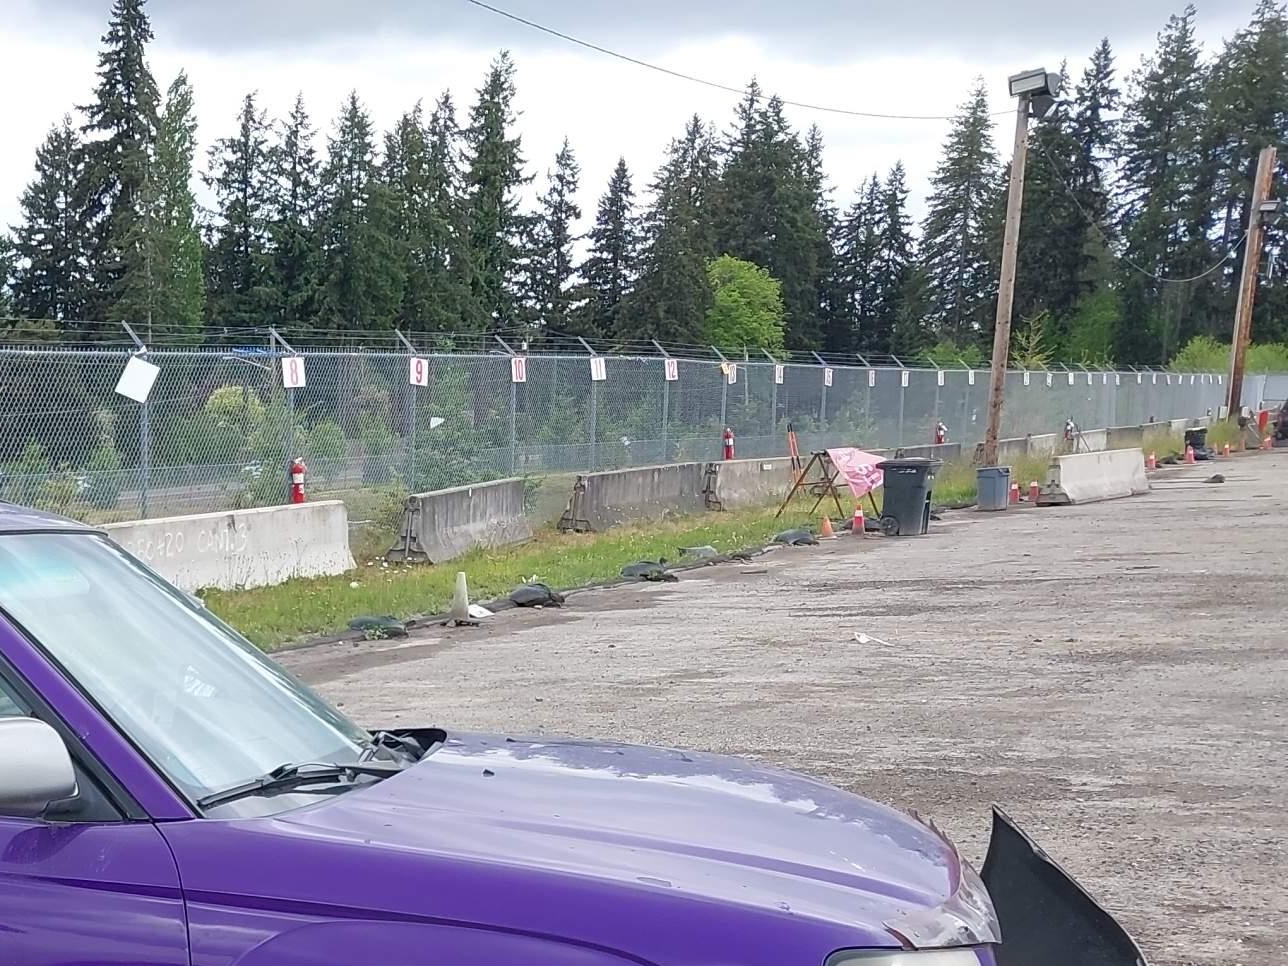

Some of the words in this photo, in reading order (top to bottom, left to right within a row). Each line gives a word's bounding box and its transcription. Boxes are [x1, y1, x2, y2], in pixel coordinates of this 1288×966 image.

[289, 358, 299, 386] 8
[415, 359, 423, 384] 9
[514, 359, 524, 381] 10
[594, 358, 603, 380] 11
[667, 360, 677, 379] 12
